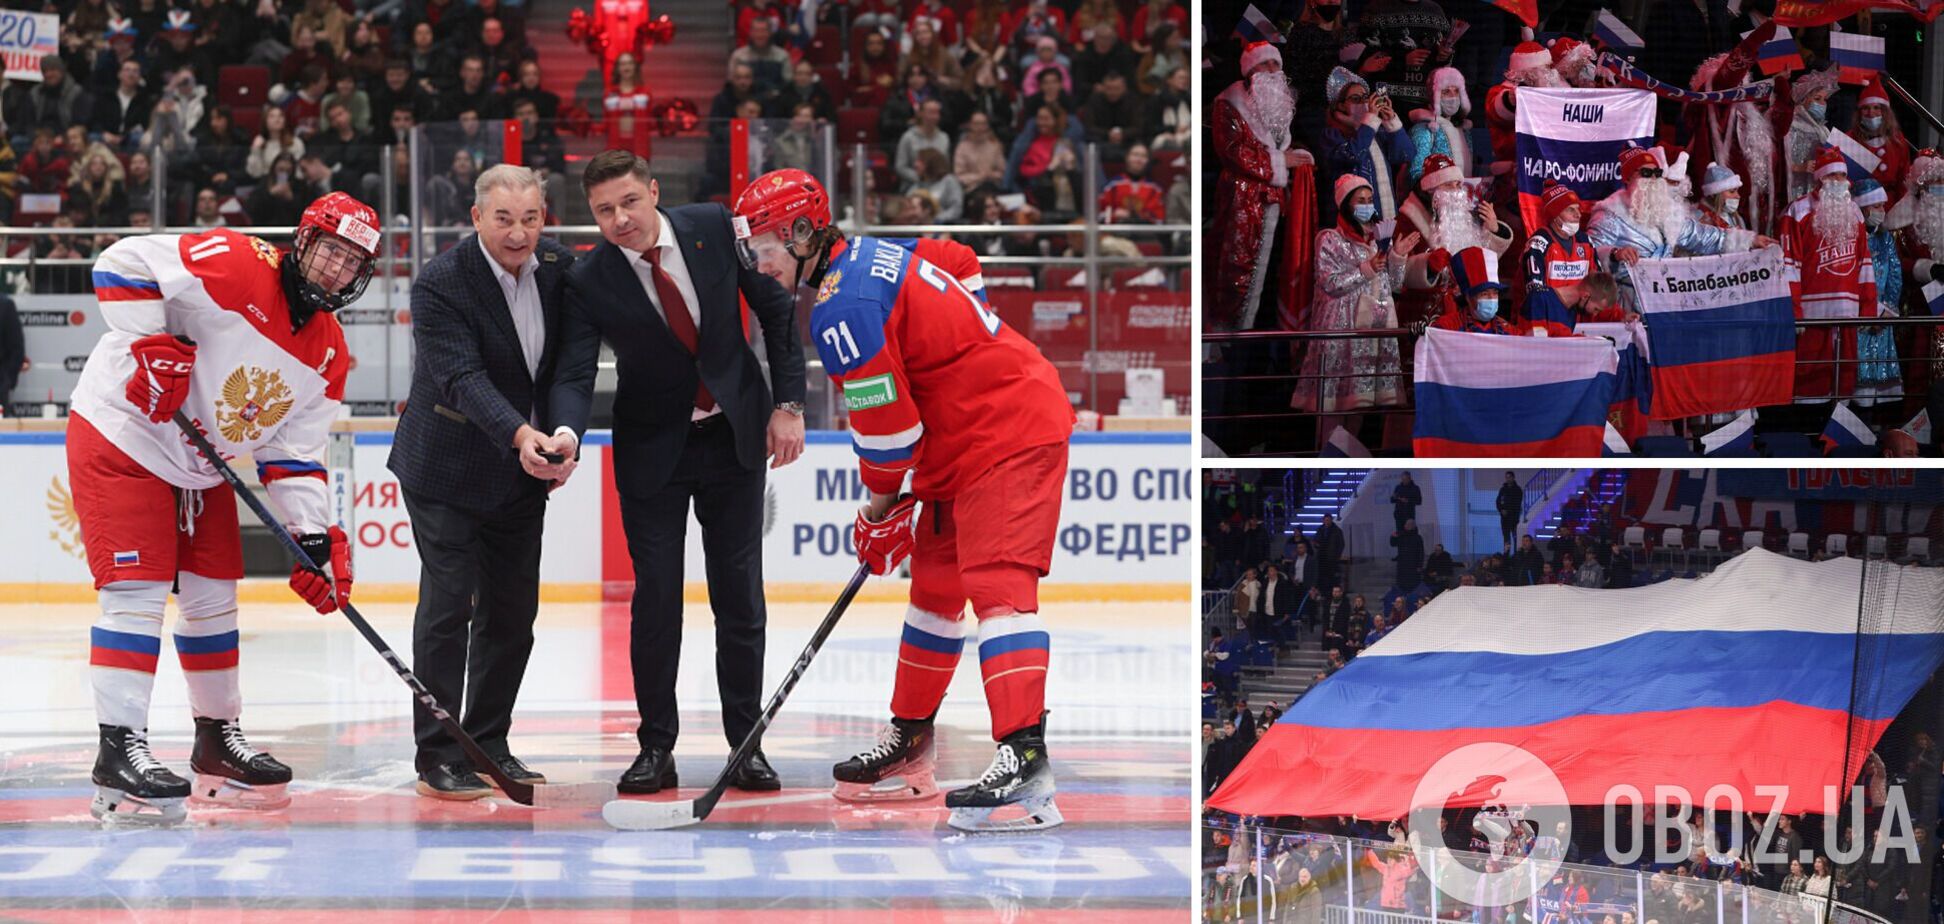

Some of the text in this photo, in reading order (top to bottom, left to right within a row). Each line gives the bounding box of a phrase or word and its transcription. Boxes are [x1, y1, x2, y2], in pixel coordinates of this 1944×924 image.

[1562, 103, 1604, 123] НАШИ
[189, 236, 231, 262] 11
[1666, 267, 1771, 293] Балабаново
[822, 320, 861, 366] 21
[1059, 522, 1191, 562] ФЕДЕР
[1539, 898, 1560, 911] СКА
